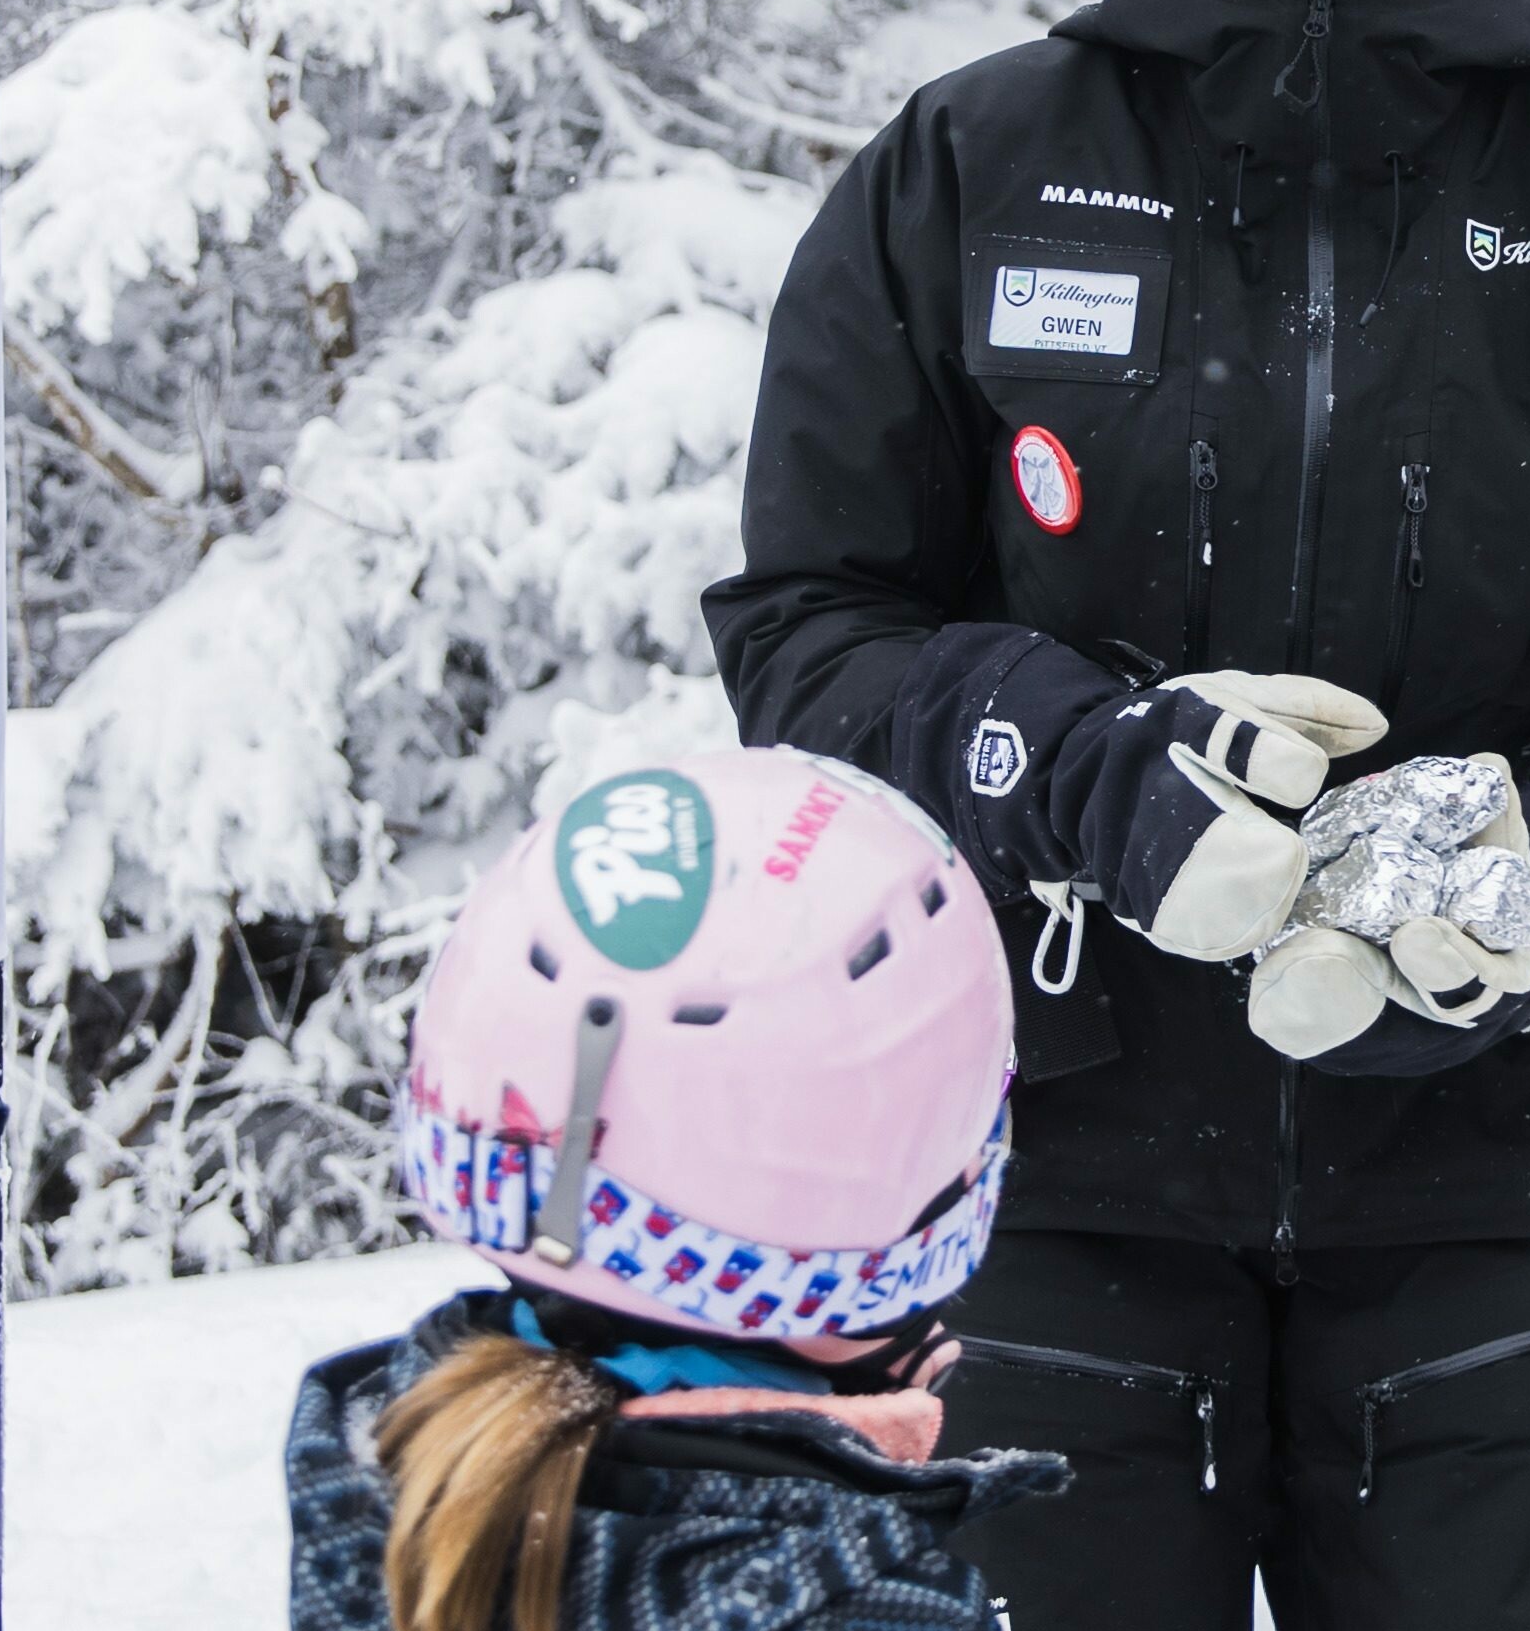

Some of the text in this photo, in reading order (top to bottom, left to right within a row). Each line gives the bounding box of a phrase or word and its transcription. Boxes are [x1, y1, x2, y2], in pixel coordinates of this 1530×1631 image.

[1041, 185, 1174, 220] MAMMUT
[1039, 281, 1134, 310] Killington
[1041, 316, 1102, 337] GWEN
[978, 736, 993, 780] HESTRA
[764, 780, 846, 883] SAMMY
[857, 1226, 970, 1311] SMITH
